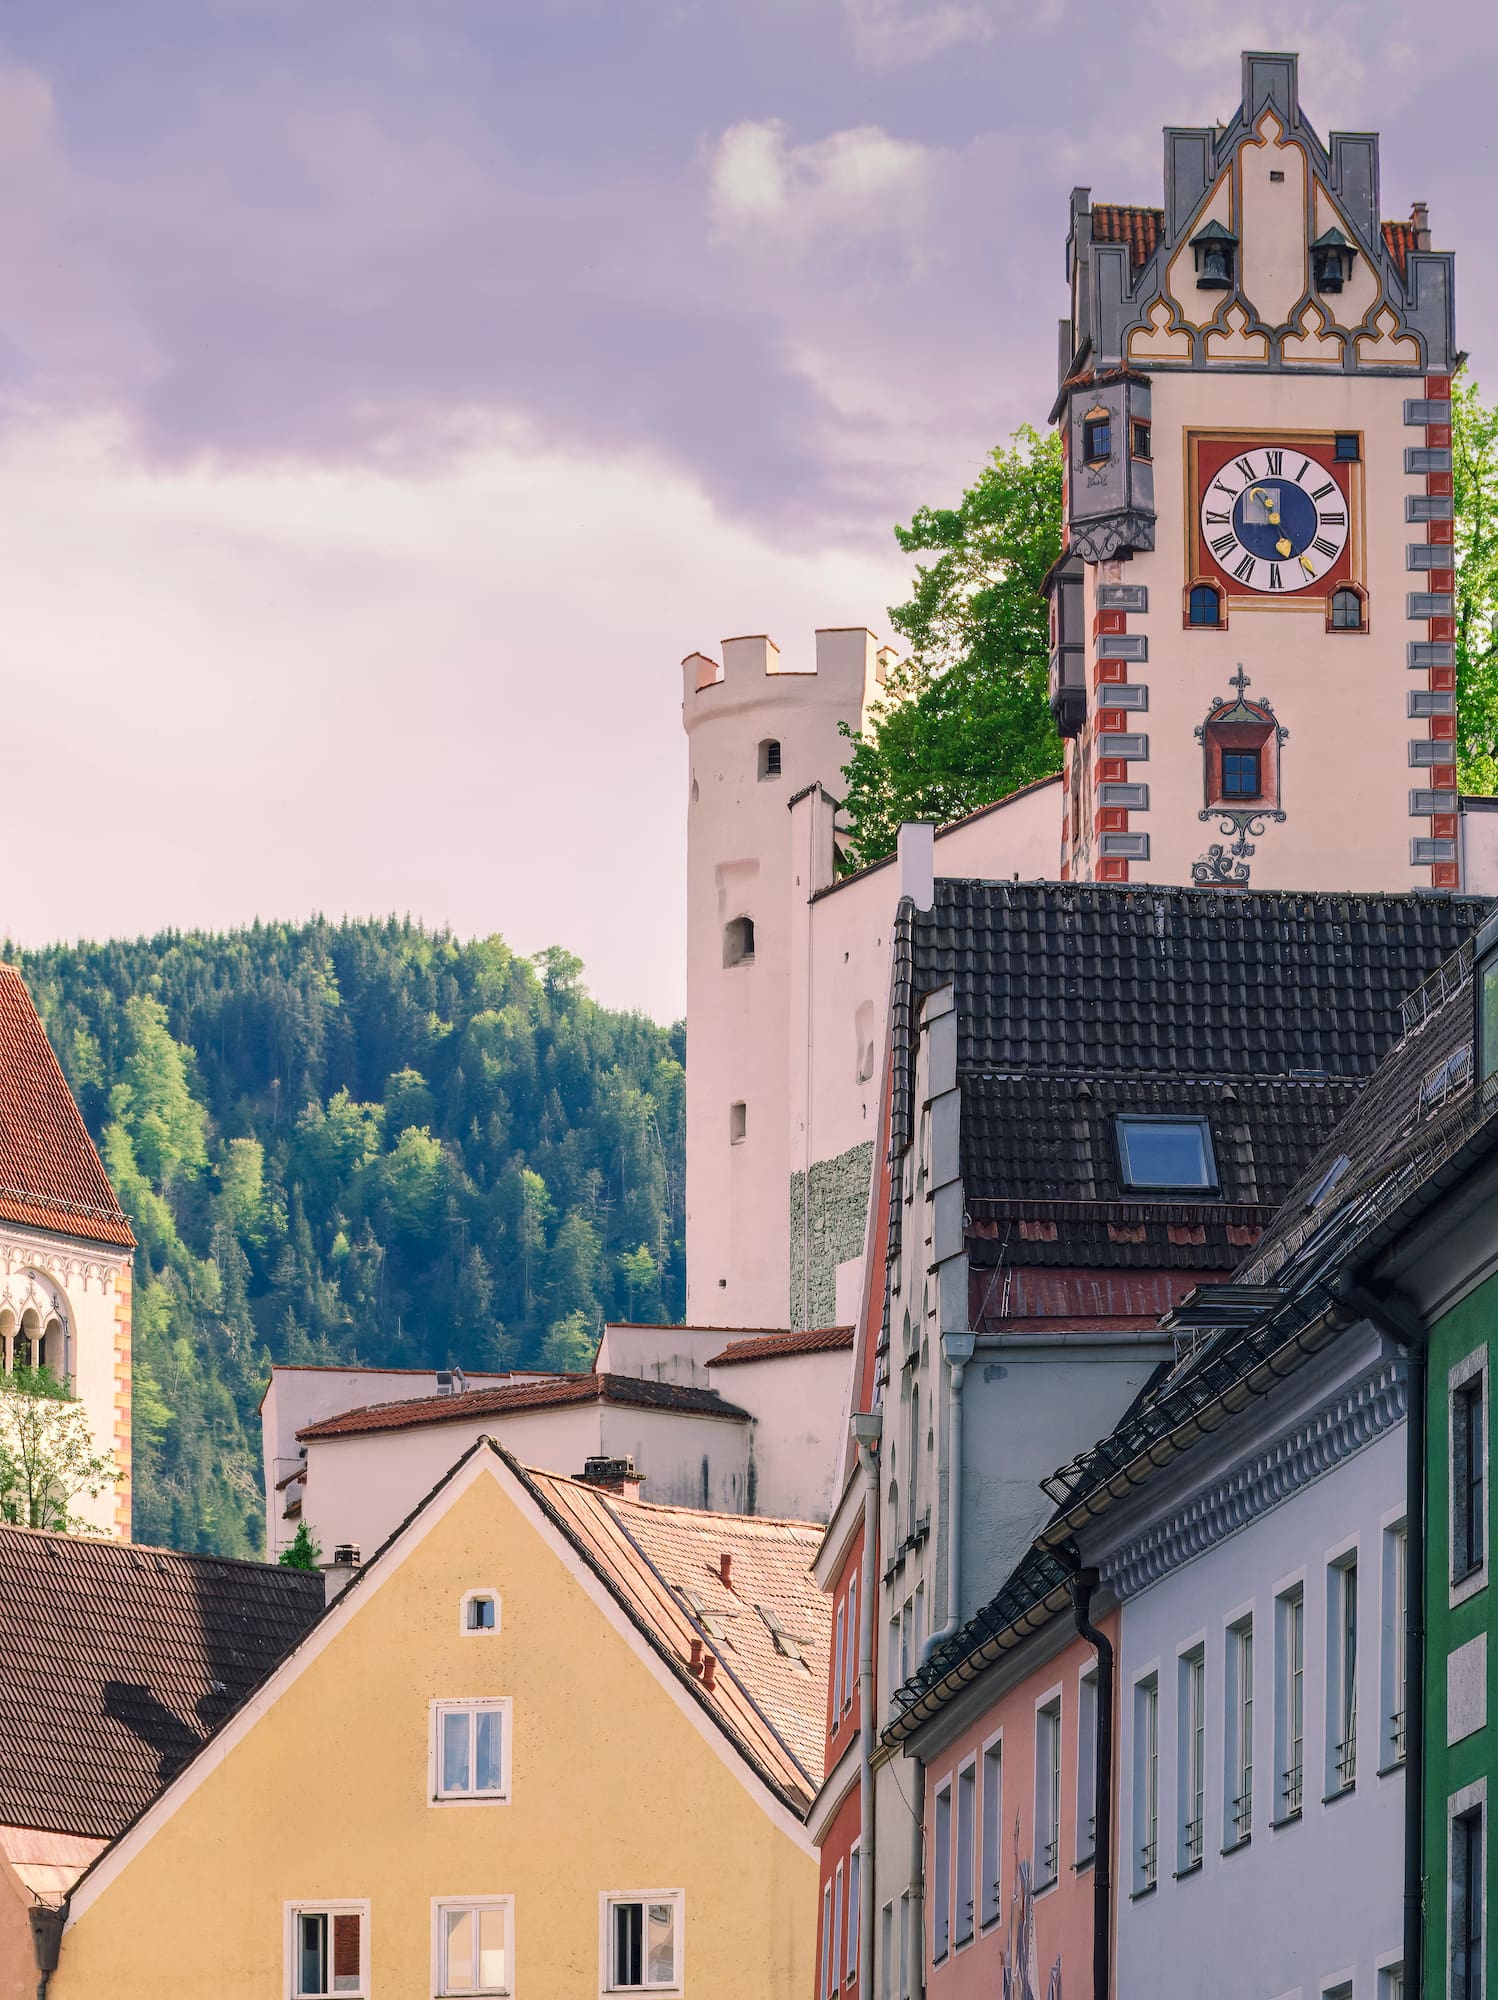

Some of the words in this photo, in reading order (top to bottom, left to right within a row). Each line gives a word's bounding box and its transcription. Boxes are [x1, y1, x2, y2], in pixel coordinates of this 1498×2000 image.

[1235, 457, 1257, 483] XI
[1265, 451, 1283, 476] XII
[1296, 460, 1311, 482] I
[1214, 478, 1238, 501] X
[1311, 482, 1335, 501] II
[1206, 509, 1230, 525] IX
[1320, 512, 1345, 526] III
